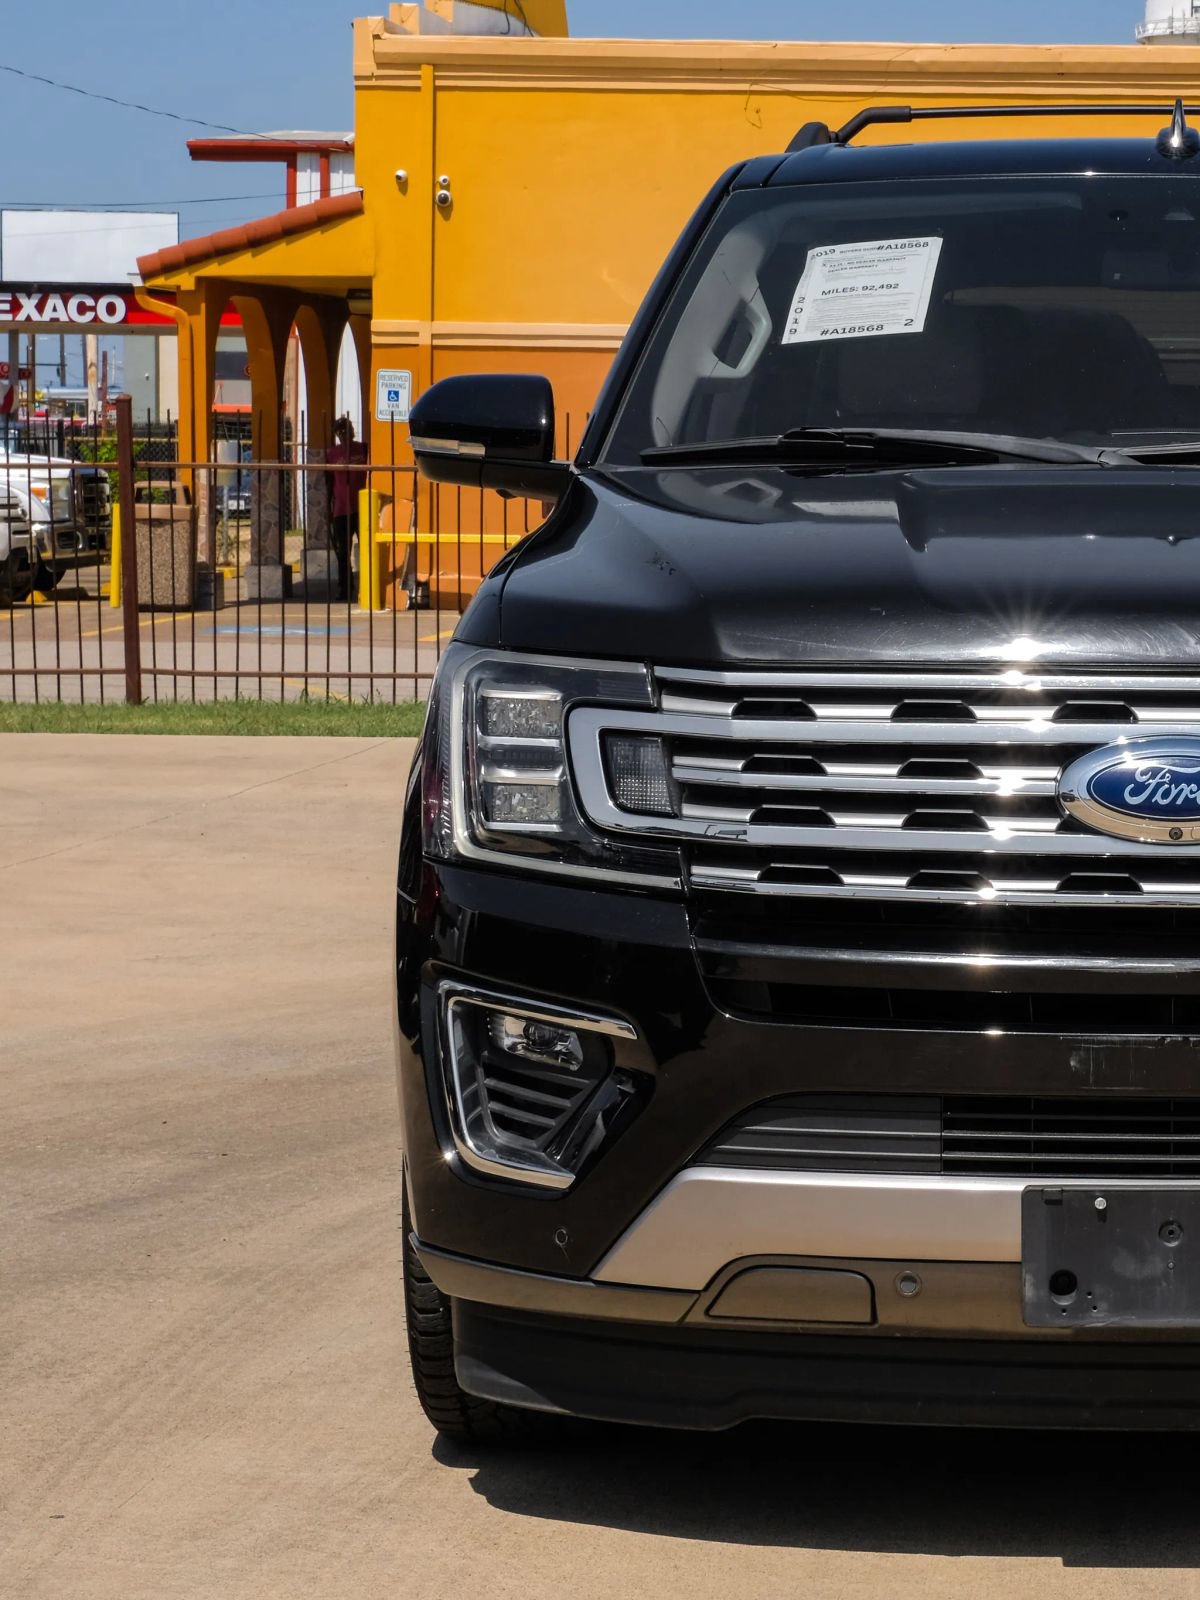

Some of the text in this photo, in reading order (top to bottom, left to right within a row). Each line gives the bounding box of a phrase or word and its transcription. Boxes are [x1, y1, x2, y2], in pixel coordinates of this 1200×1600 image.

[877, 241, 929, 251] #A18568
[821, 283, 899, 296] MILES: 92,492
[903, 318, 914, 327] 2
[820, 324, 884, 336] #A18568
